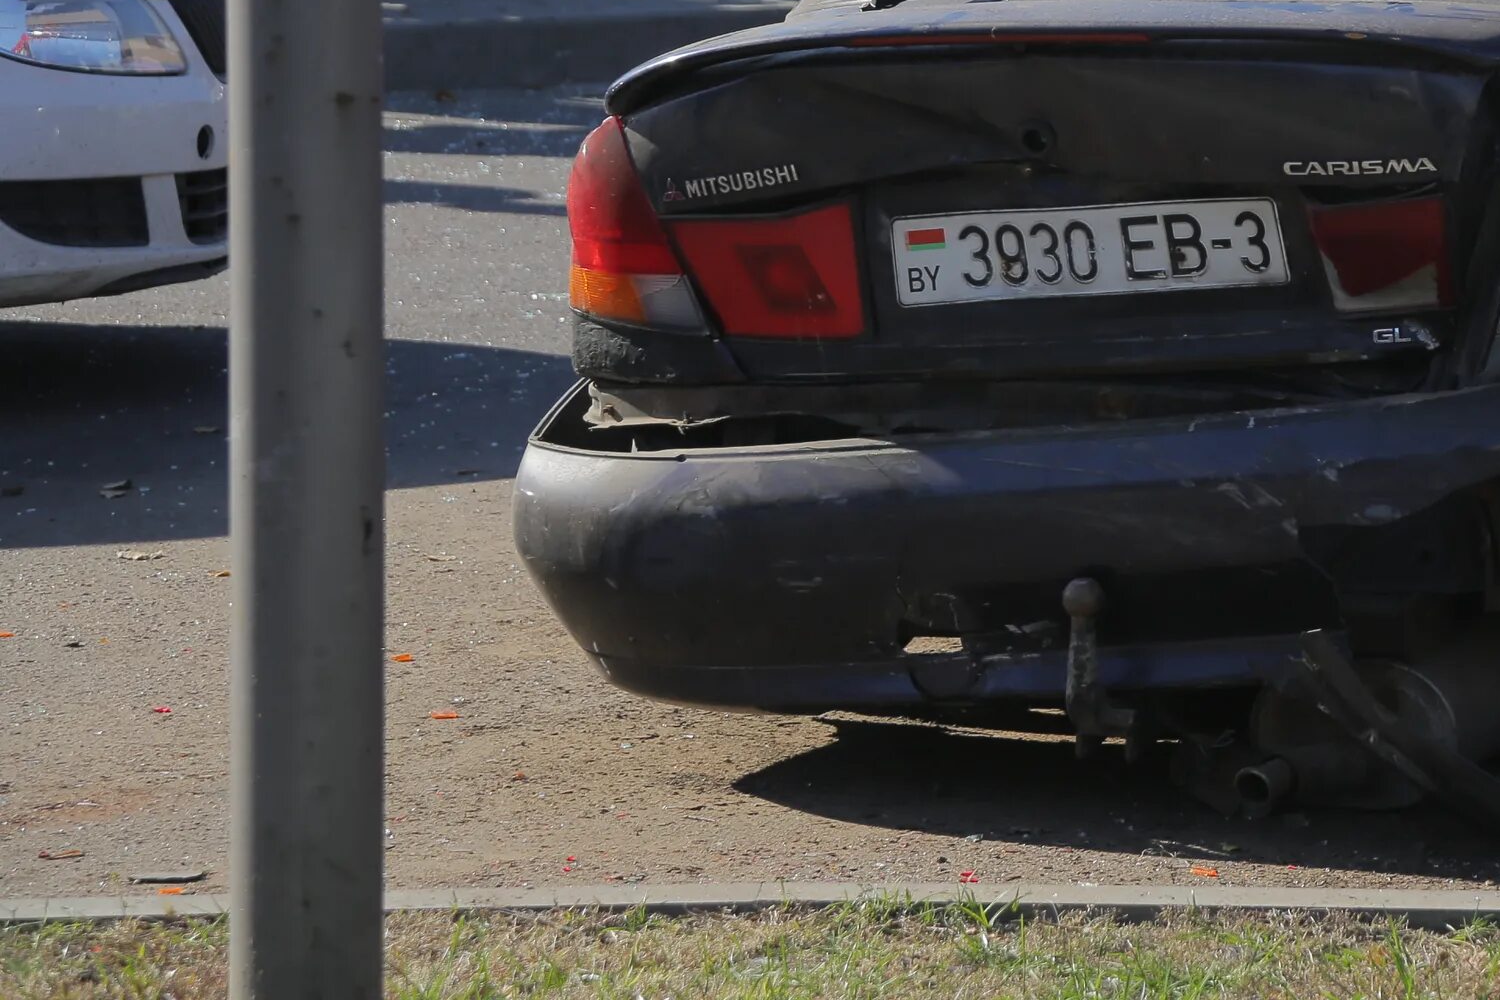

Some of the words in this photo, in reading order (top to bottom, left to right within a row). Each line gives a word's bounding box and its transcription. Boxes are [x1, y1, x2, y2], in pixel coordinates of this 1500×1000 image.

[685, 164, 799, 198] MITSUBISHI
[1283, 157, 1438, 176] CARISMA
[958, 220, 1098, 287] 3930
[1120, 210, 1271, 281] EB-3
[908, 265, 940, 293] BY
